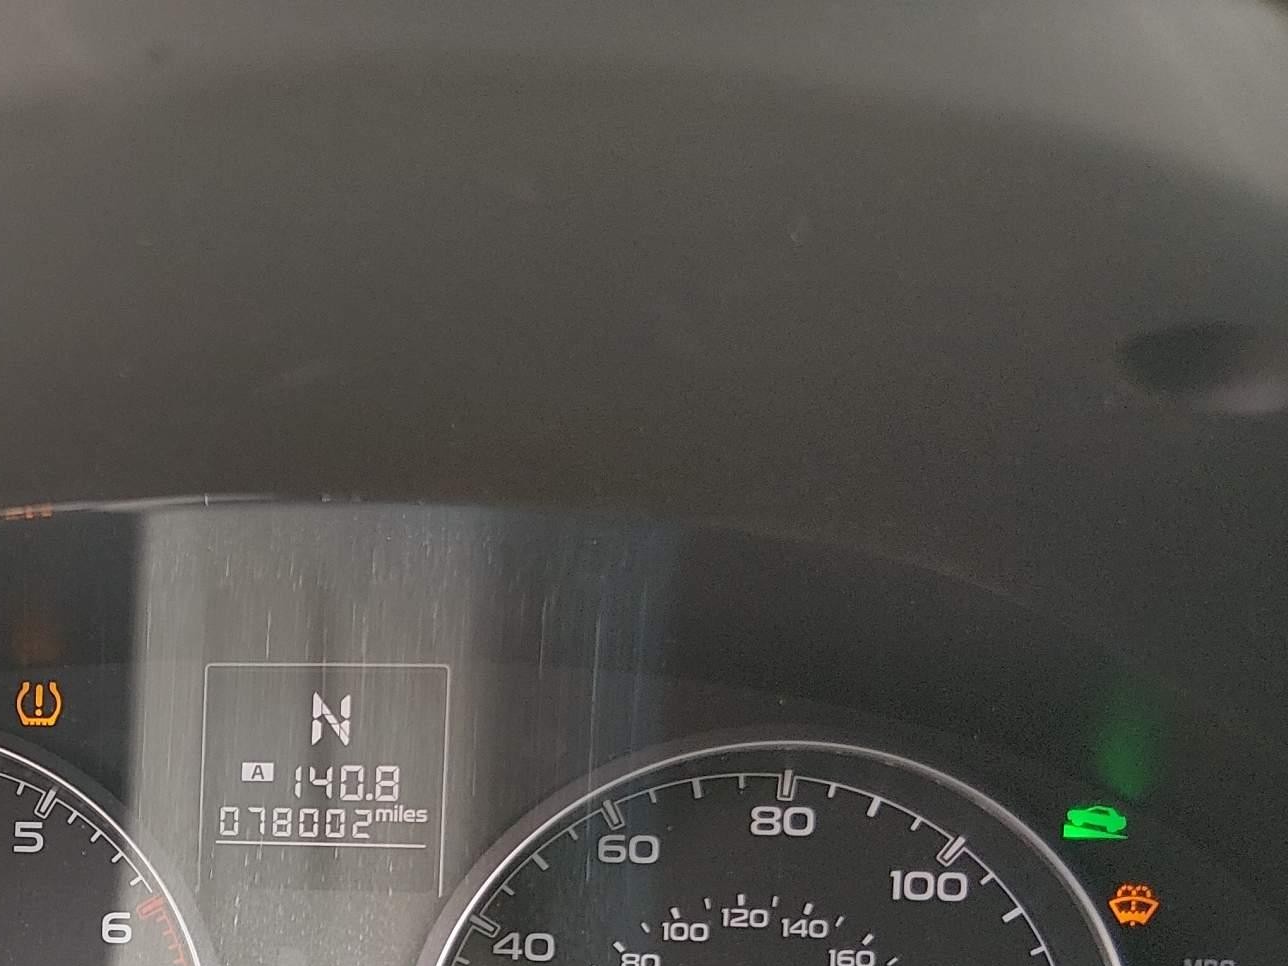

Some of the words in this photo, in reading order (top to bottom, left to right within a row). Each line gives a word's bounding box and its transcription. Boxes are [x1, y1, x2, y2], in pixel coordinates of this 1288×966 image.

[312, 691, 351, 746] N
[294, 765, 400, 801] 140.8
[220, 806, 372, 839] 078002
[375, 805, 428, 823] miles
[751, 806, 815, 836] 80
[13, 822, 44, 853] 5
[598, 835, 660, 864] 60
[890, 870, 968, 901] 100
[101, 913, 132, 944] 6
[662, 922, 709, 942] 100
[721, 908, 769, 928] 120
[781, 918, 828, 938] 140
[492, 933, 555, 962] 40
